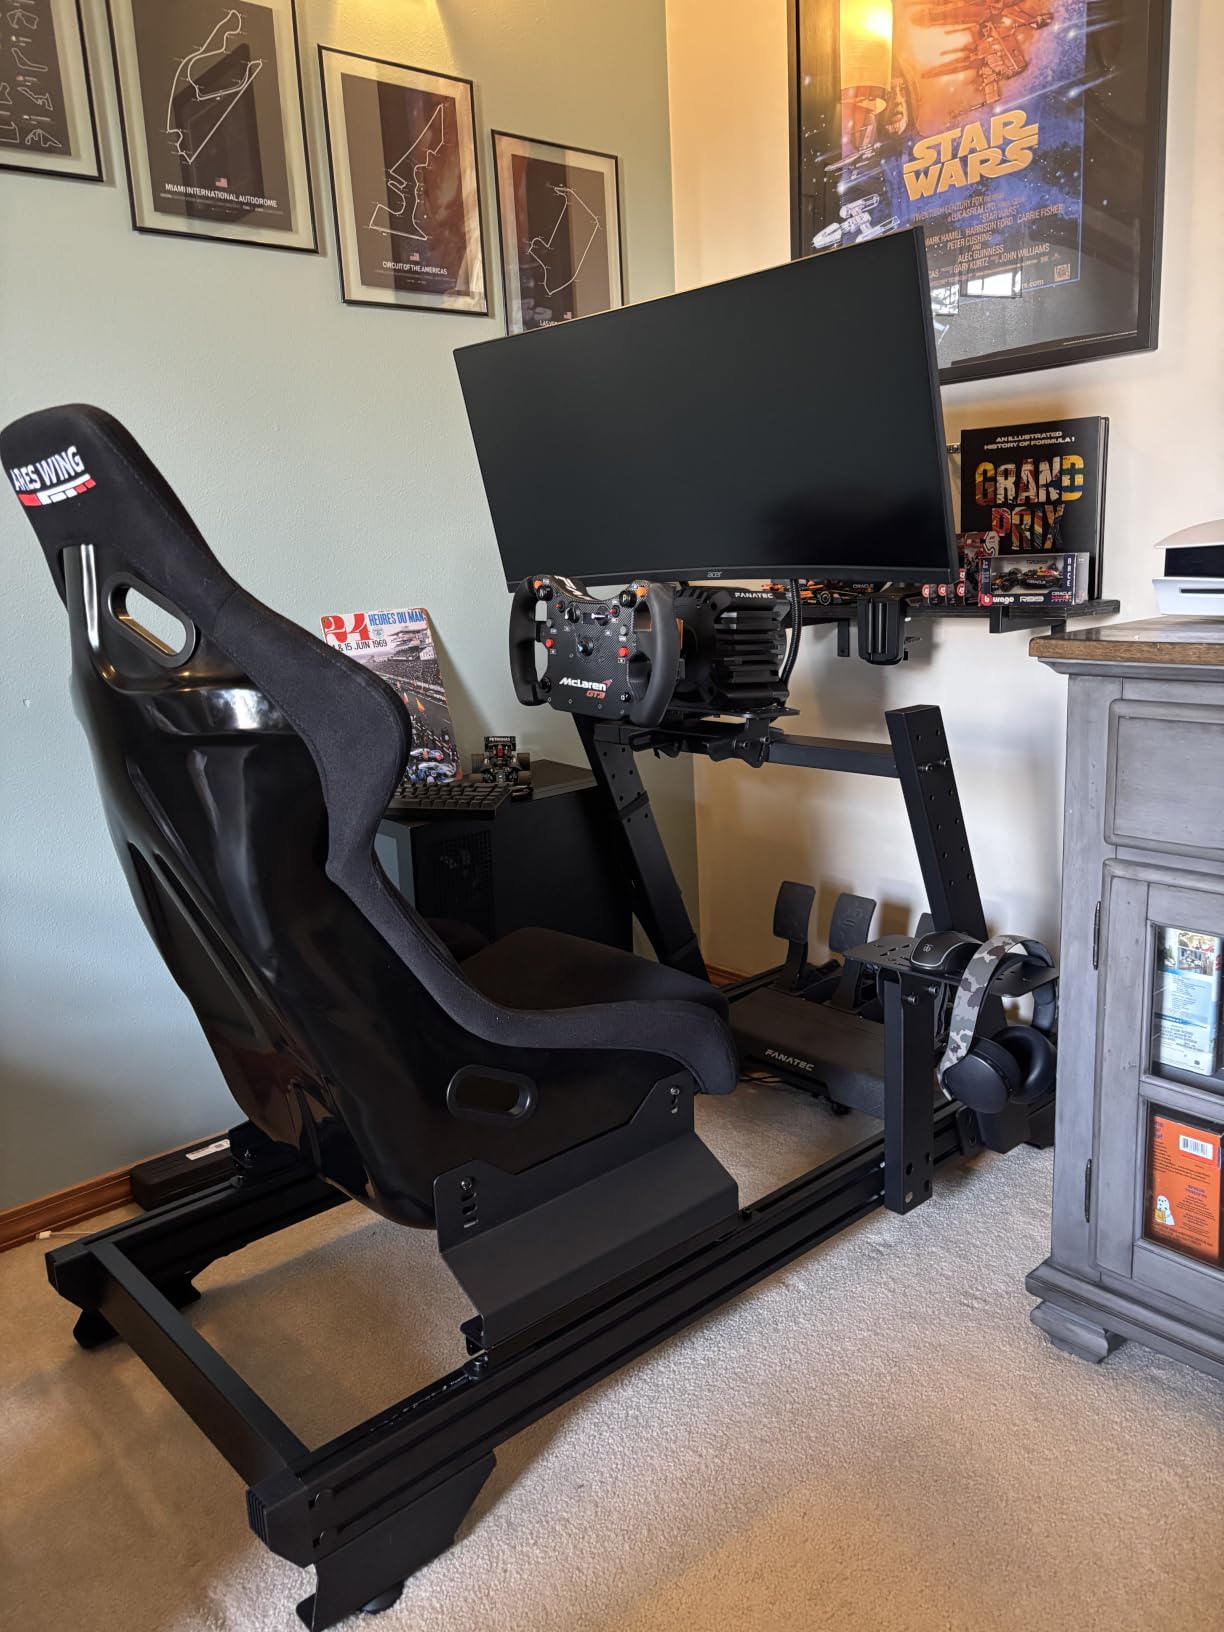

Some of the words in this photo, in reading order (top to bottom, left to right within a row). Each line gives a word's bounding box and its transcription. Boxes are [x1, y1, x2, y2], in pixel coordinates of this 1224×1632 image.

[904, 110, 1039, 174] STAR
[904, 135, 1039, 200] WARS
[165, 183, 186, 193] MIAMI
[186, 187, 238, 202] INTERNATIONAL
[239, 195, 278, 208] AUTODROME
[972, 195, 985, 206] FOX
[941, 229, 963, 242] HAMILL
[965, 221, 997, 236] HARRISON
[997, 217, 1014, 229] FORD
[1017, 209, 1041, 224] CARRIE
[1040, 203, 1065, 217] FISHER
[947, 238, 965, 250] PETER
[965, 231, 993, 246] CUSHING
[972, 243, 982, 251] AND
[953, 262, 970, 273] GARY
[969, 258, 989, 270] KURTZ
[1000, 250, 1017, 263] JOHN
[1017, 243, 1050, 258] WILLIAMS
[958, 251, 973, 262] ALEC
[973, 244, 1004, 259] GUINNESS
[382, 261, 403, 270] CIRCUIT
[422, 266, 448, 275] AMERICAS
[984, 442, 1018, 450] HISTORY
[1030, 437, 1071, 446] FORMULA
[1008, 431, 1063, 441] ILLUSTRATED
[35, 445, 85, 486] WING
[975, 454, 1084, 506] GRAND
[992, 503, 1066, 550] PRIX
[734, 591, 774, 599] FANATEC
[321, 613, 373, 643] 24
[368, 612, 397, 627] HEURES
[396, 611, 407, 624] DU
[407, 610, 426, 623] MAN
[344, 642, 353, 651] 15
[354, 641, 371, 650] JUIN
[371, 639, 388, 649] 1969
[559, 677, 607, 691] McLaren
[585, 690, 606, 700] GT3
[765, 1049, 815, 1072] FANATEC
